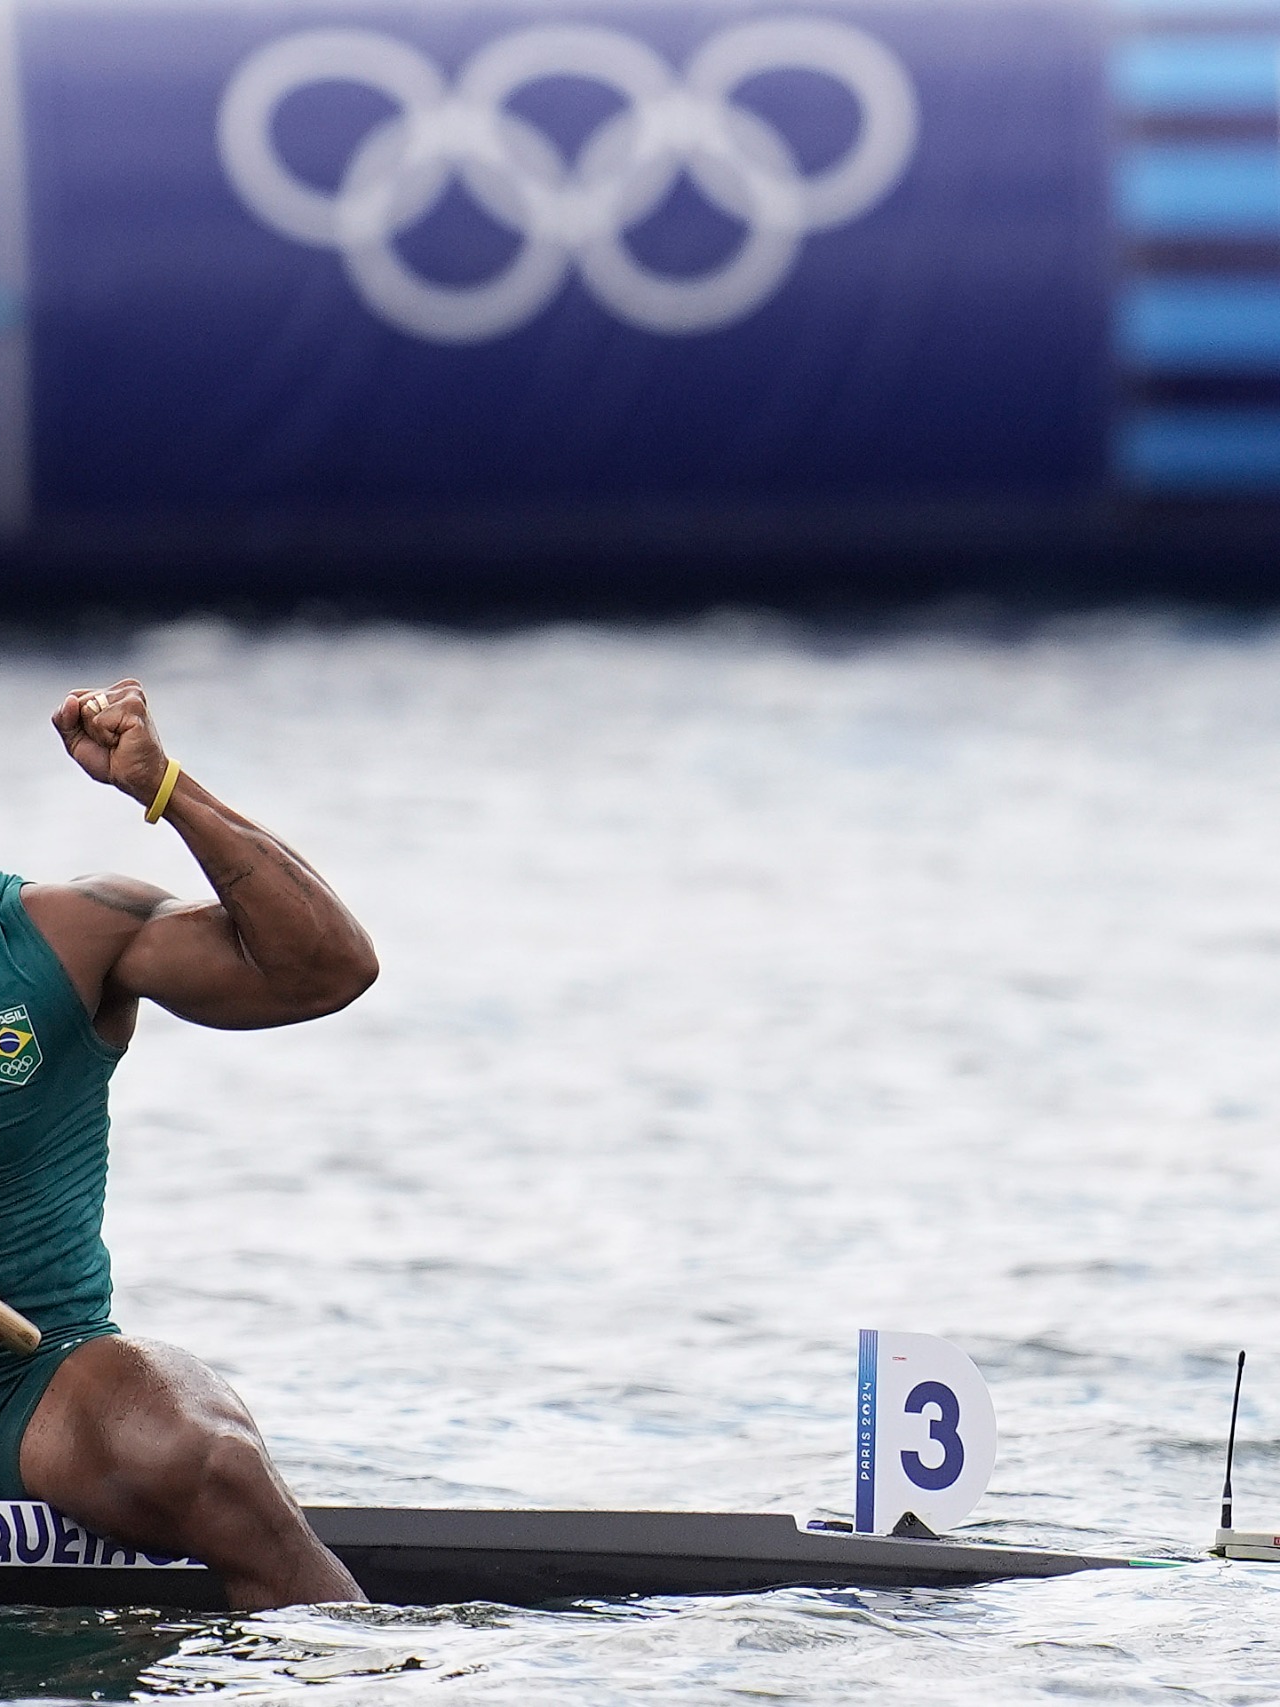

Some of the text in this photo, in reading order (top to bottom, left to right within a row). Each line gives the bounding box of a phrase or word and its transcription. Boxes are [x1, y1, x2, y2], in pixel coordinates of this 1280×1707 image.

[860, 1382, 872, 1480] PARIS 2024
[900, 1381, 964, 1490] 3
